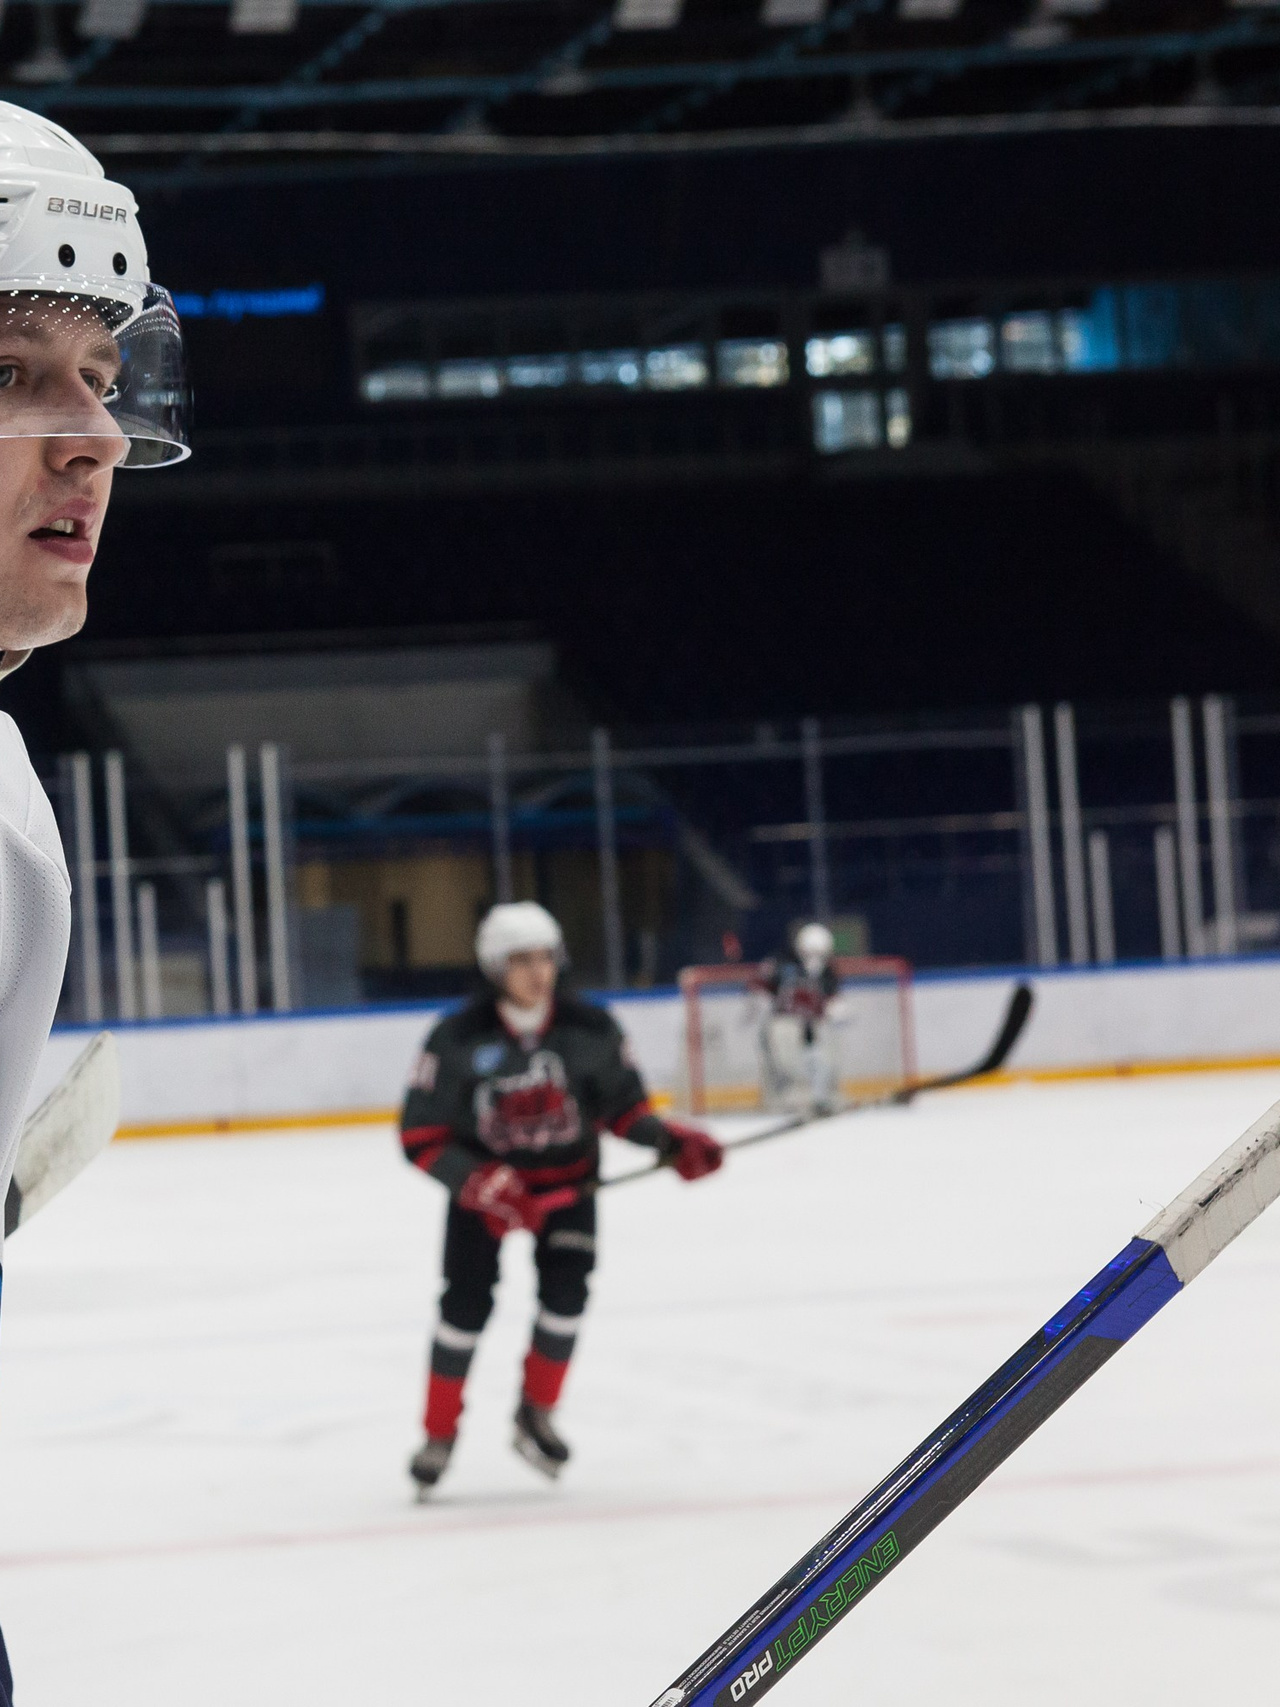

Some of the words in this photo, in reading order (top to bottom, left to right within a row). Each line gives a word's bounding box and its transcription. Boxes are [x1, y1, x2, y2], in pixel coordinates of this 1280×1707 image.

[47, 197, 127, 223] BAUER
[776, 1530, 900, 1672] ENCRYPT
[730, 1650, 773, 1701] PRO
